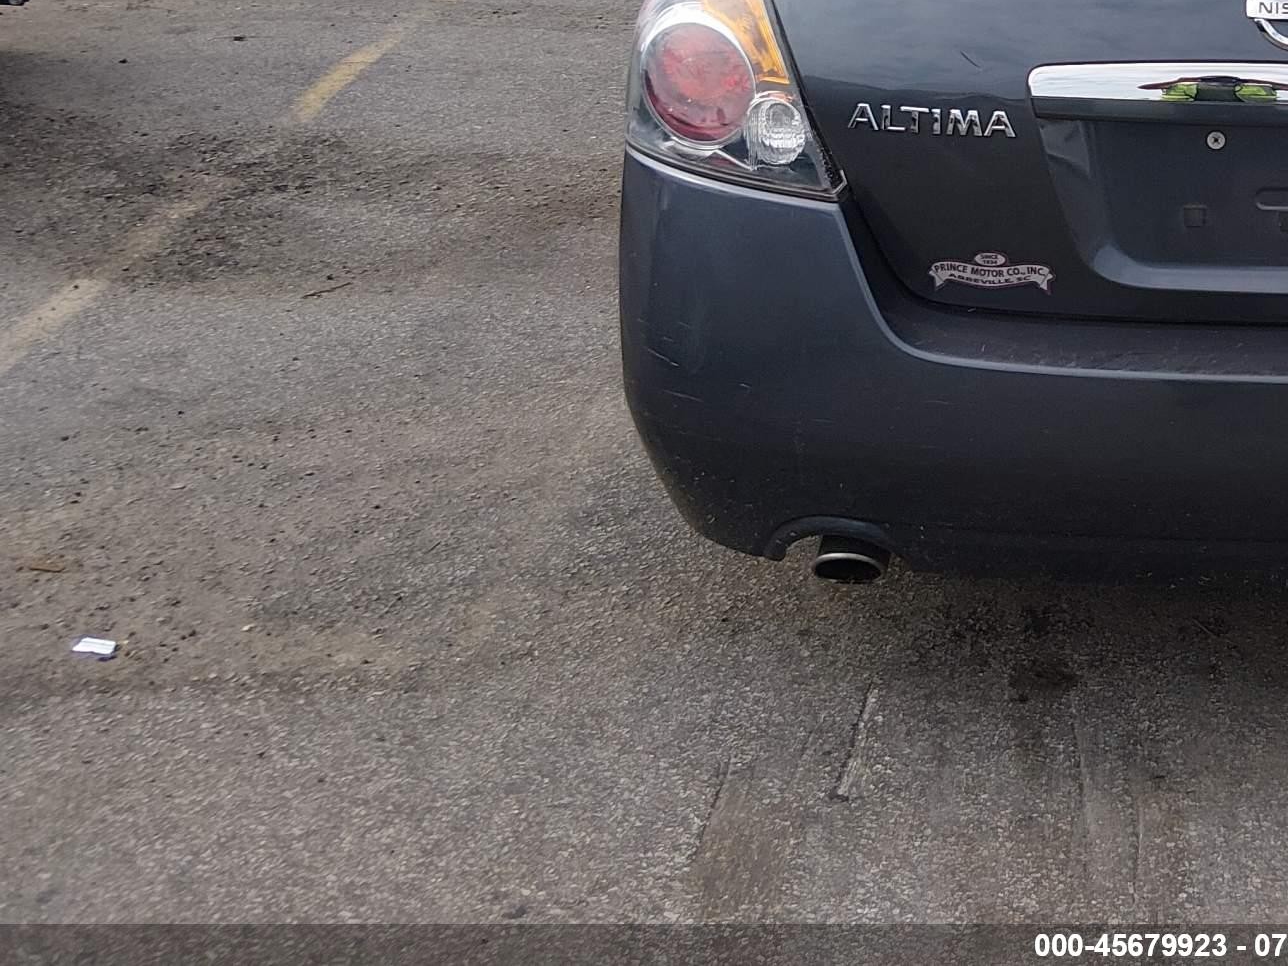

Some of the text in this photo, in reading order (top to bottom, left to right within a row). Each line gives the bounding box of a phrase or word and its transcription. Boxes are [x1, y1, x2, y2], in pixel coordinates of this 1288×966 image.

[847, 102, 1017, 138] ALTIMA
[933, 263, 968, 274] PRINCE
[970, 267, 1005, 277] MOTOR
